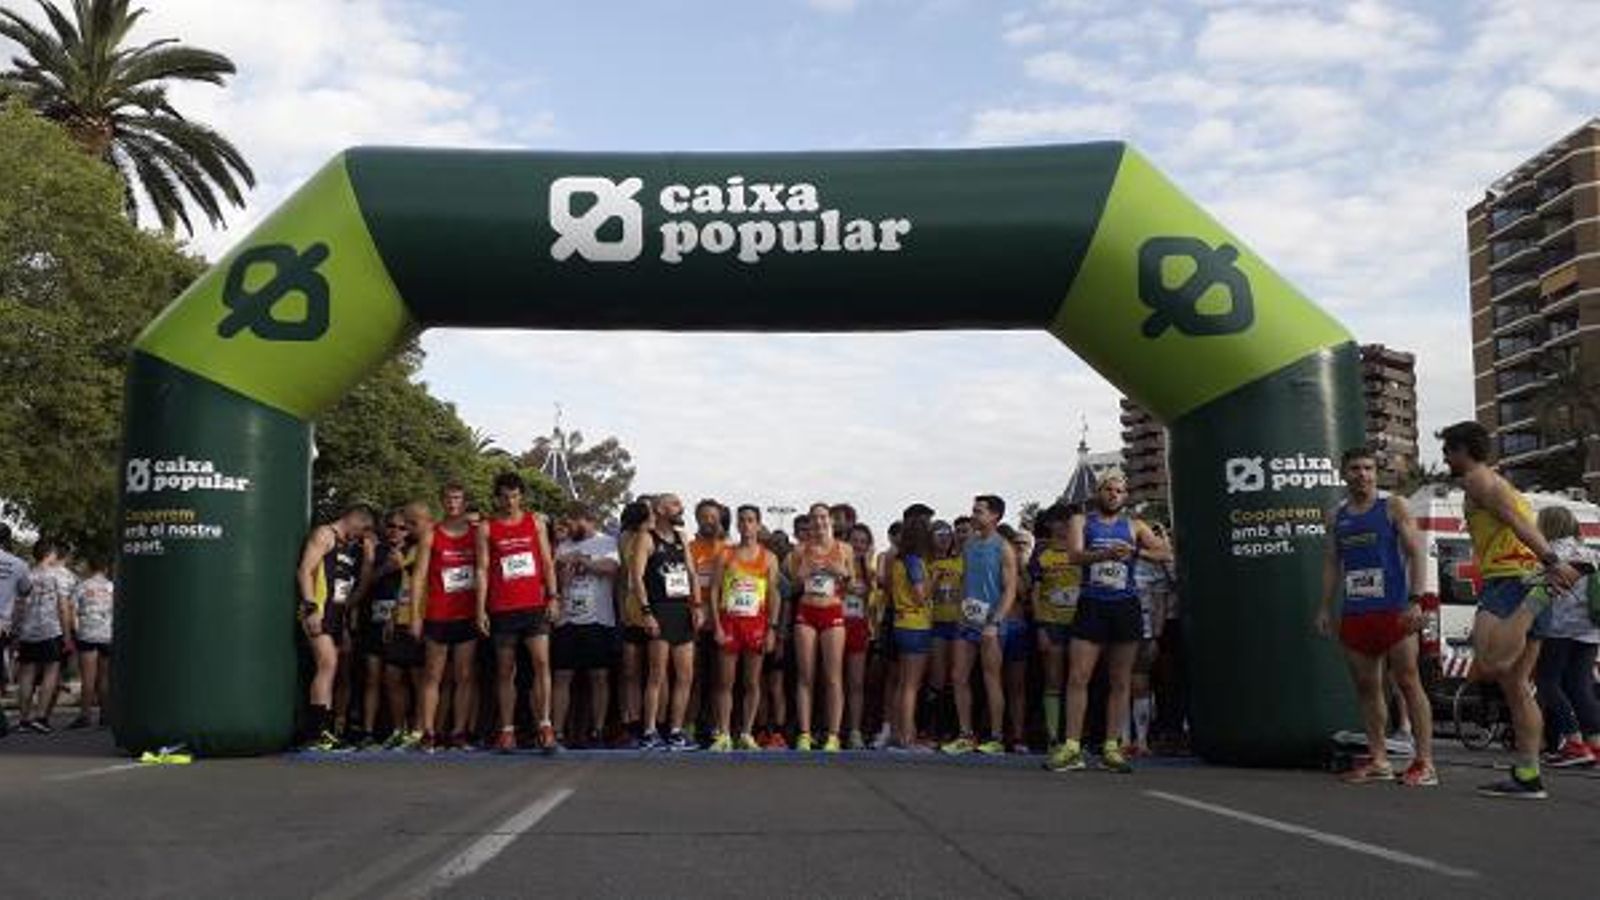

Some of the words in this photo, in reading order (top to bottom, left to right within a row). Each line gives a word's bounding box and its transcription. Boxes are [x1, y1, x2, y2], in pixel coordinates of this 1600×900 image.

[659, 176, 820, 213] caixa
[660, 209, 912, 264] popular
[154, 456, 214, 473] caixa
[1269, 453, 1332, 471] caixa
[154, 472, 251, 491] popular
[127, 509, 195, 522] ooperem
[1231, 508, 1321, 522] Cooperem
[151, 524, 165, 536] el
[168, 524, 223, 537] nostre
[1232, 524, 1268, 539] amb
[1273, 522, 1292, 538] el
[1296, 525, 1326, 536] nos
[1233, 541, 1294, 556] esport.
